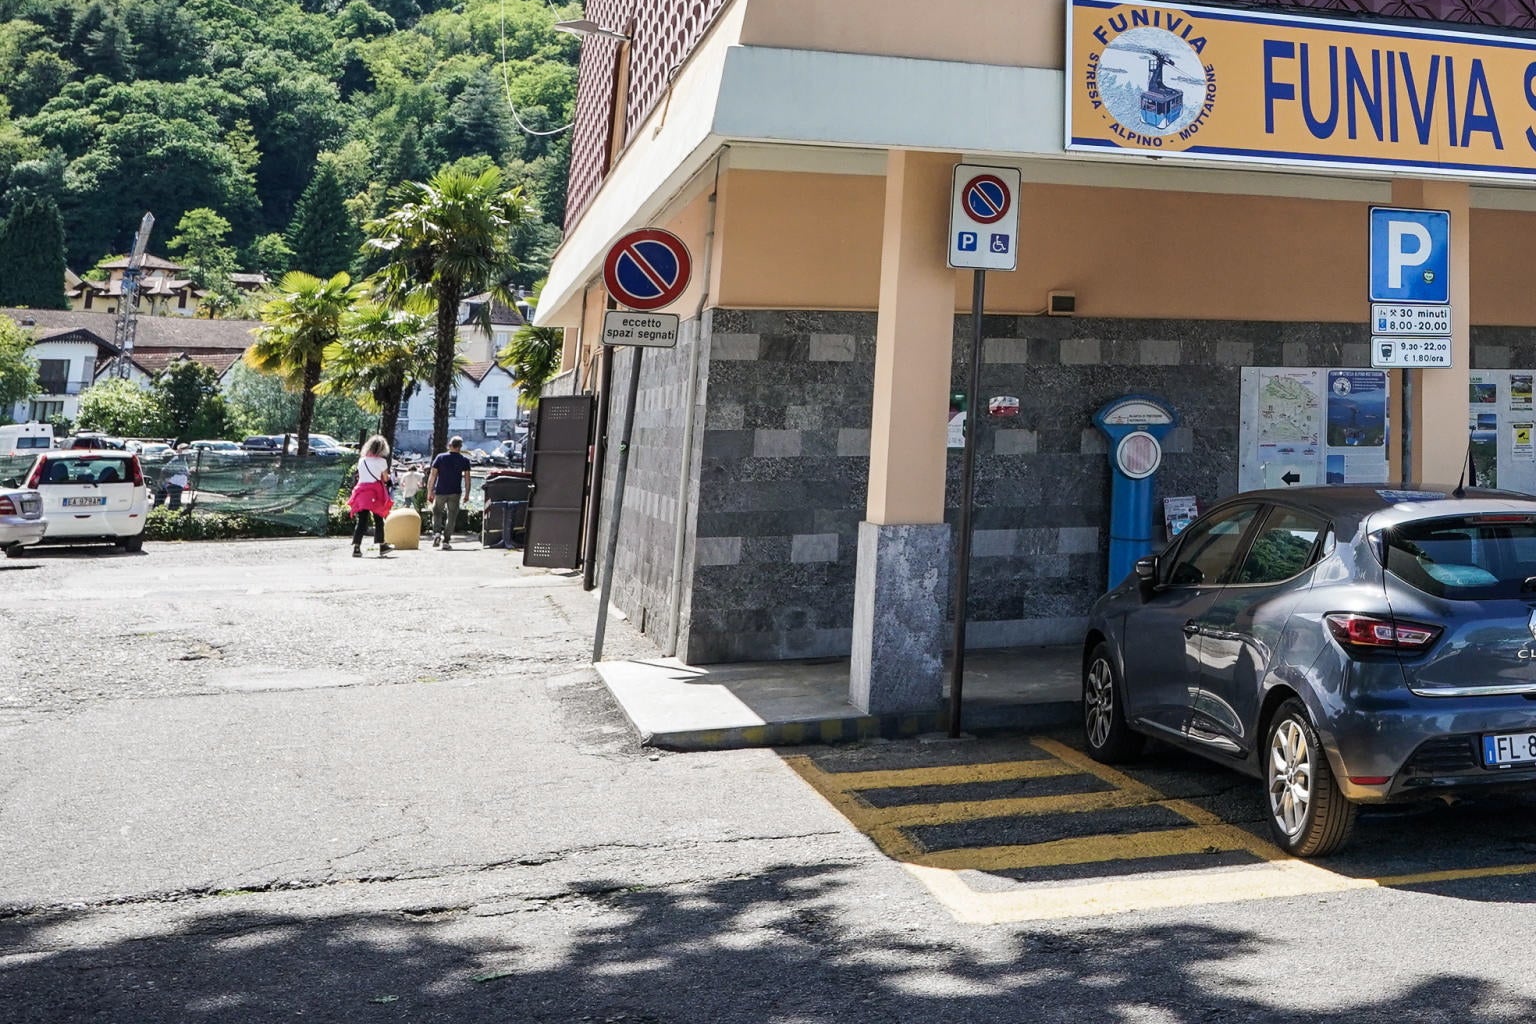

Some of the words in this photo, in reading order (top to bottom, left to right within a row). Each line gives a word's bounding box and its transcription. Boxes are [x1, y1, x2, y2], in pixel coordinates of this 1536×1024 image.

[1093, 8, 1207, 55] FUNIVIA
[1086, 52, 1102, 110] STRESA
[1109, 123, 1163, 147] ALPINO
[1179, 63, 1217, 141] MOTTARONE
[1263, 39, 1504, 151] FUNIVIA
[962, 233, 975, 249] P
[1388, 220, 1432, 289] P
[622, 318, 662, 328] eccetto
[1400, 308, 1413, 318] 30
[1417, 309, 1447, 318] minuti
[607, 328, 634, 339] spazi
[638, 330, 675, 341] segnati
